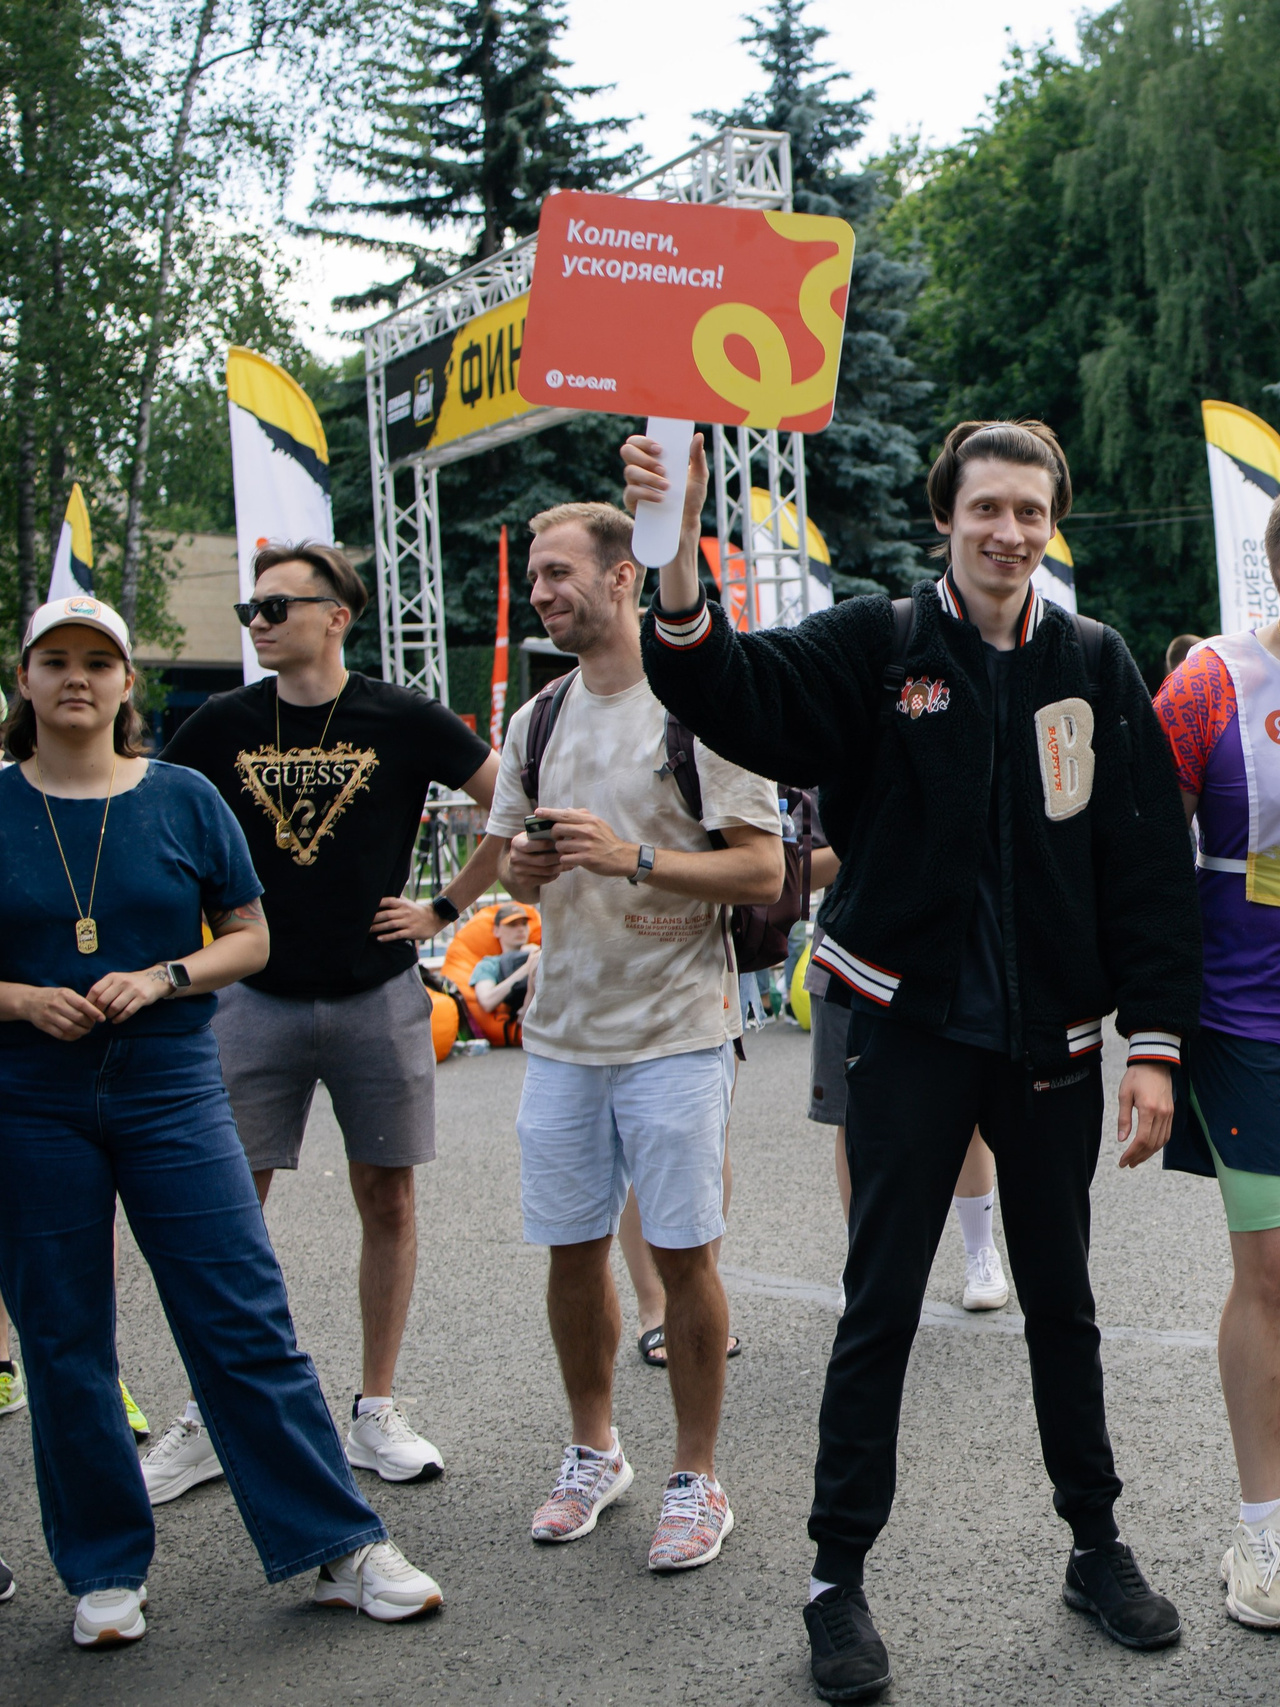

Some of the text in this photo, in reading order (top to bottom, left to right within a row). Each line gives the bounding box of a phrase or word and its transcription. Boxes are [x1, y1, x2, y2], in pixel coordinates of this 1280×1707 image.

[566, 218, 679, 256] Коллеги,
[562, 254, 724, 289] ускоряемся!
[460, 318, 526, 410] ФИН
[1204, 653, 1225, 713] Yandex
[261, 764, 346, 787] GUESS
[624, 914, 649, 924] PEPE
[651, 916, 683, 925] JEANS
